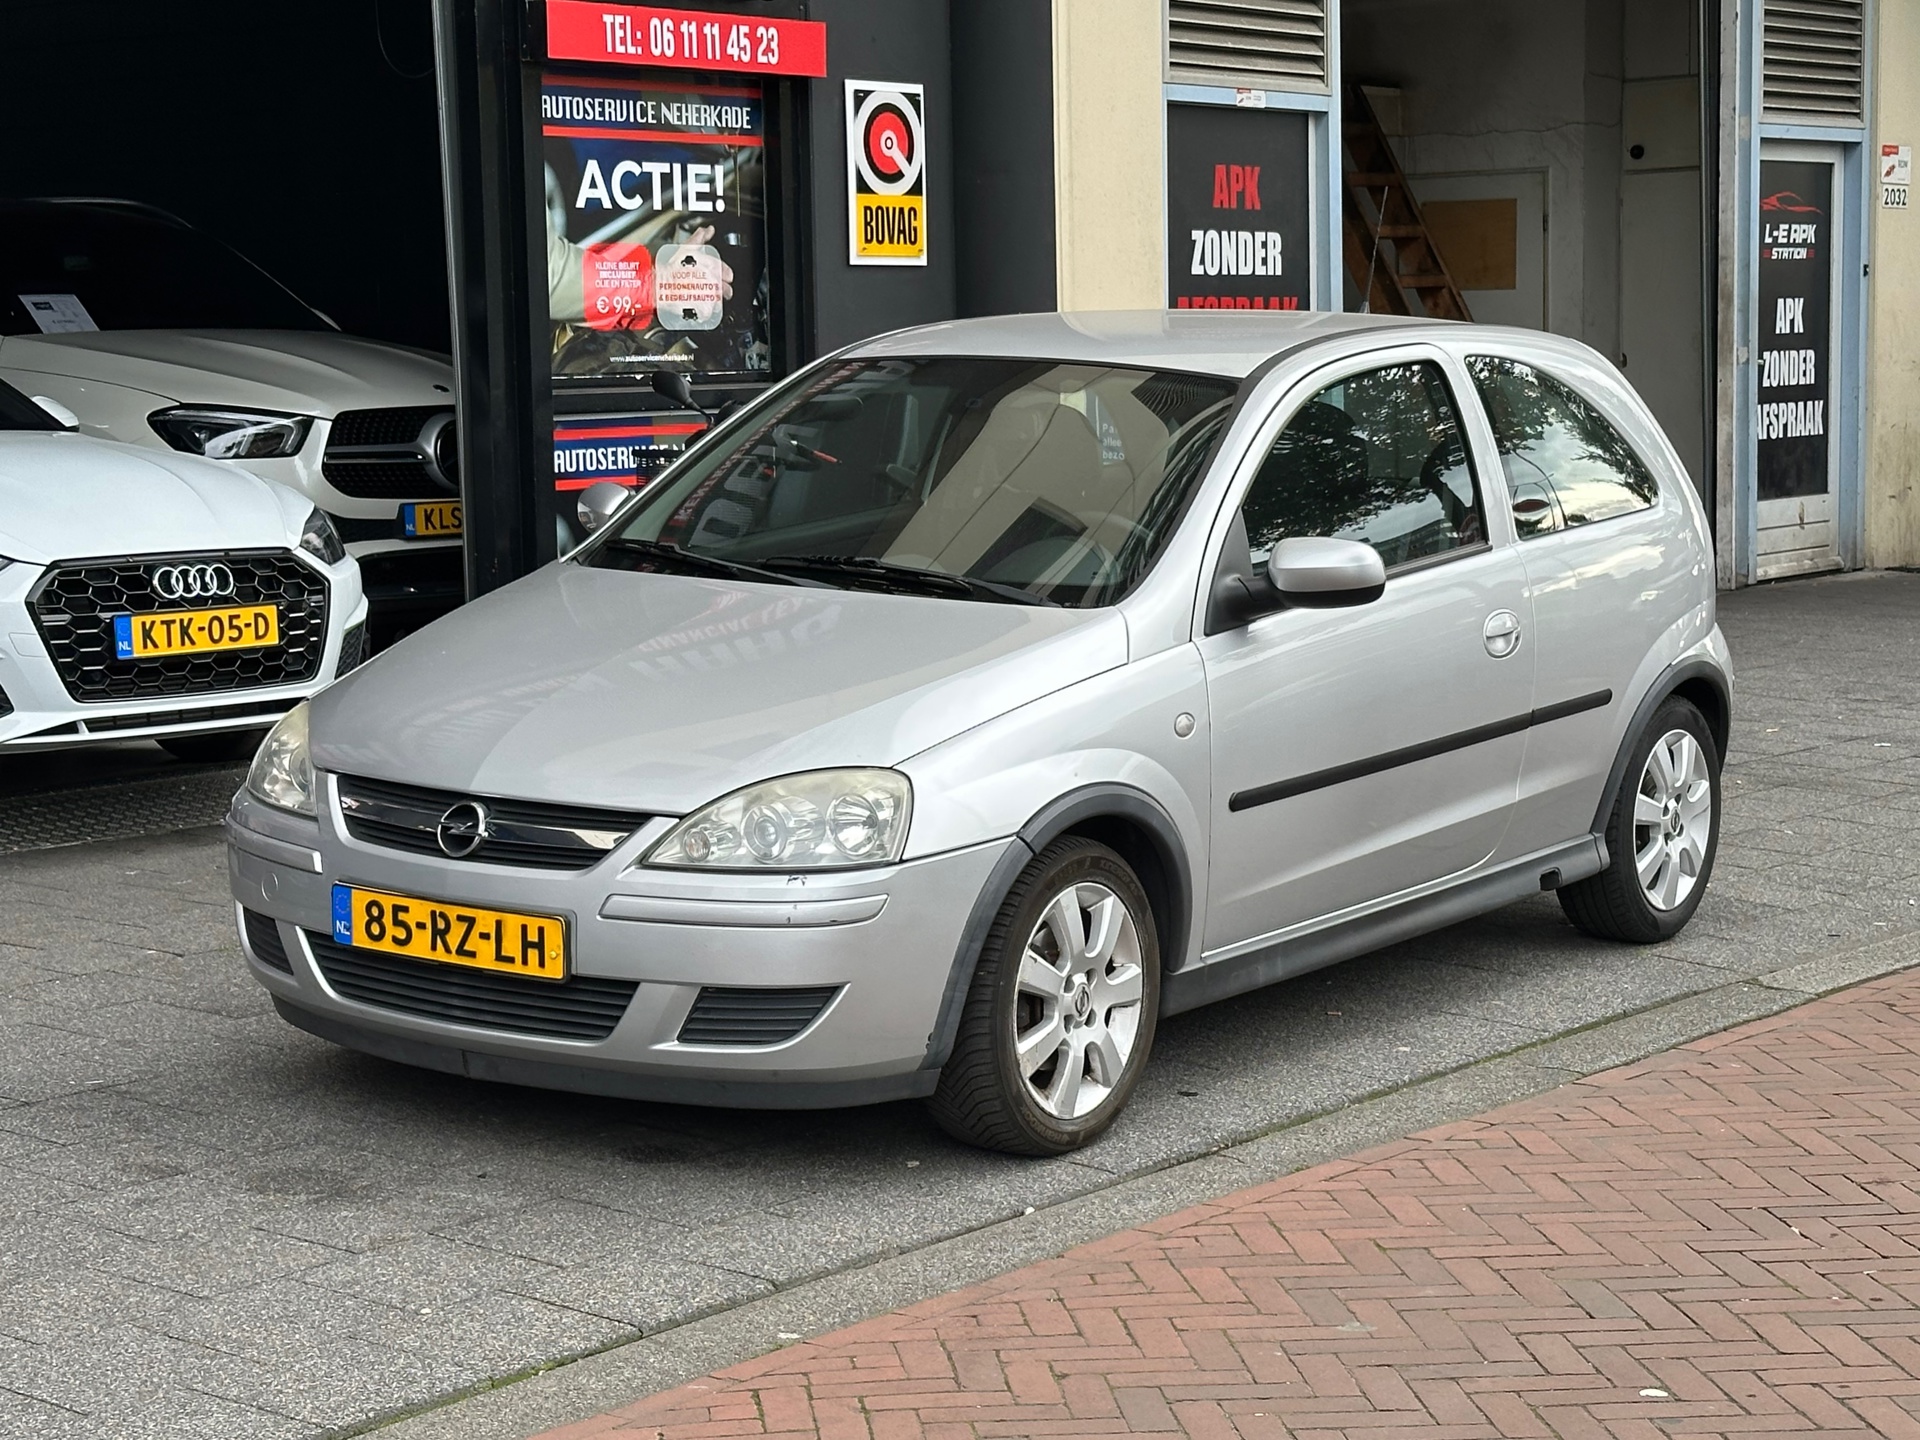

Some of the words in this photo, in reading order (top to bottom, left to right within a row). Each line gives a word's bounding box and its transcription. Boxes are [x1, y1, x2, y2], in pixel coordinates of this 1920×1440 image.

[602, 13, 643, 55] TEL:
[650, 16, 675, 58] 06
[680, 20, 700, 60] 11
[703, 21, 721, 61] 11
[727, 25, 751, 63] 45
[756, 27, 779, 65] 23
[541, 94, 657, 125] AUTOSERVICE
[661, 102, 751, 129] NEHERKADE
[575, 158, 726, 213] ACTIE!
[1212, 164, 1261, 211] APK
[1884, 187, 1907, 206] 2032
[863, 205, 918, 246] BOVAG
[1764, 223, 1790, 244] L-E
[1790, 223, 1817, 244] APK
[1191, 229, 1282, 276] ZONDER
[1770, 247, 1807, 260] STATION
[596, 296, 610, 313] €
[613, 296, 642, 315] 99,-
[1775, 297, 1804, 334] APK
[1762, 349, 1815, 388] ZONDER
[1757, 399, 1824, 440] AFSPRAAK
[405, 523, 415, 531] NL
[423, 506, 462, 531] KLS
[118, 640, 132, 652] NL
[141, 611, 271, 650] KTK-05-D
[336, 921, 350, 936] NL
[363, 899, 546, 969] 85-RZ-LH
